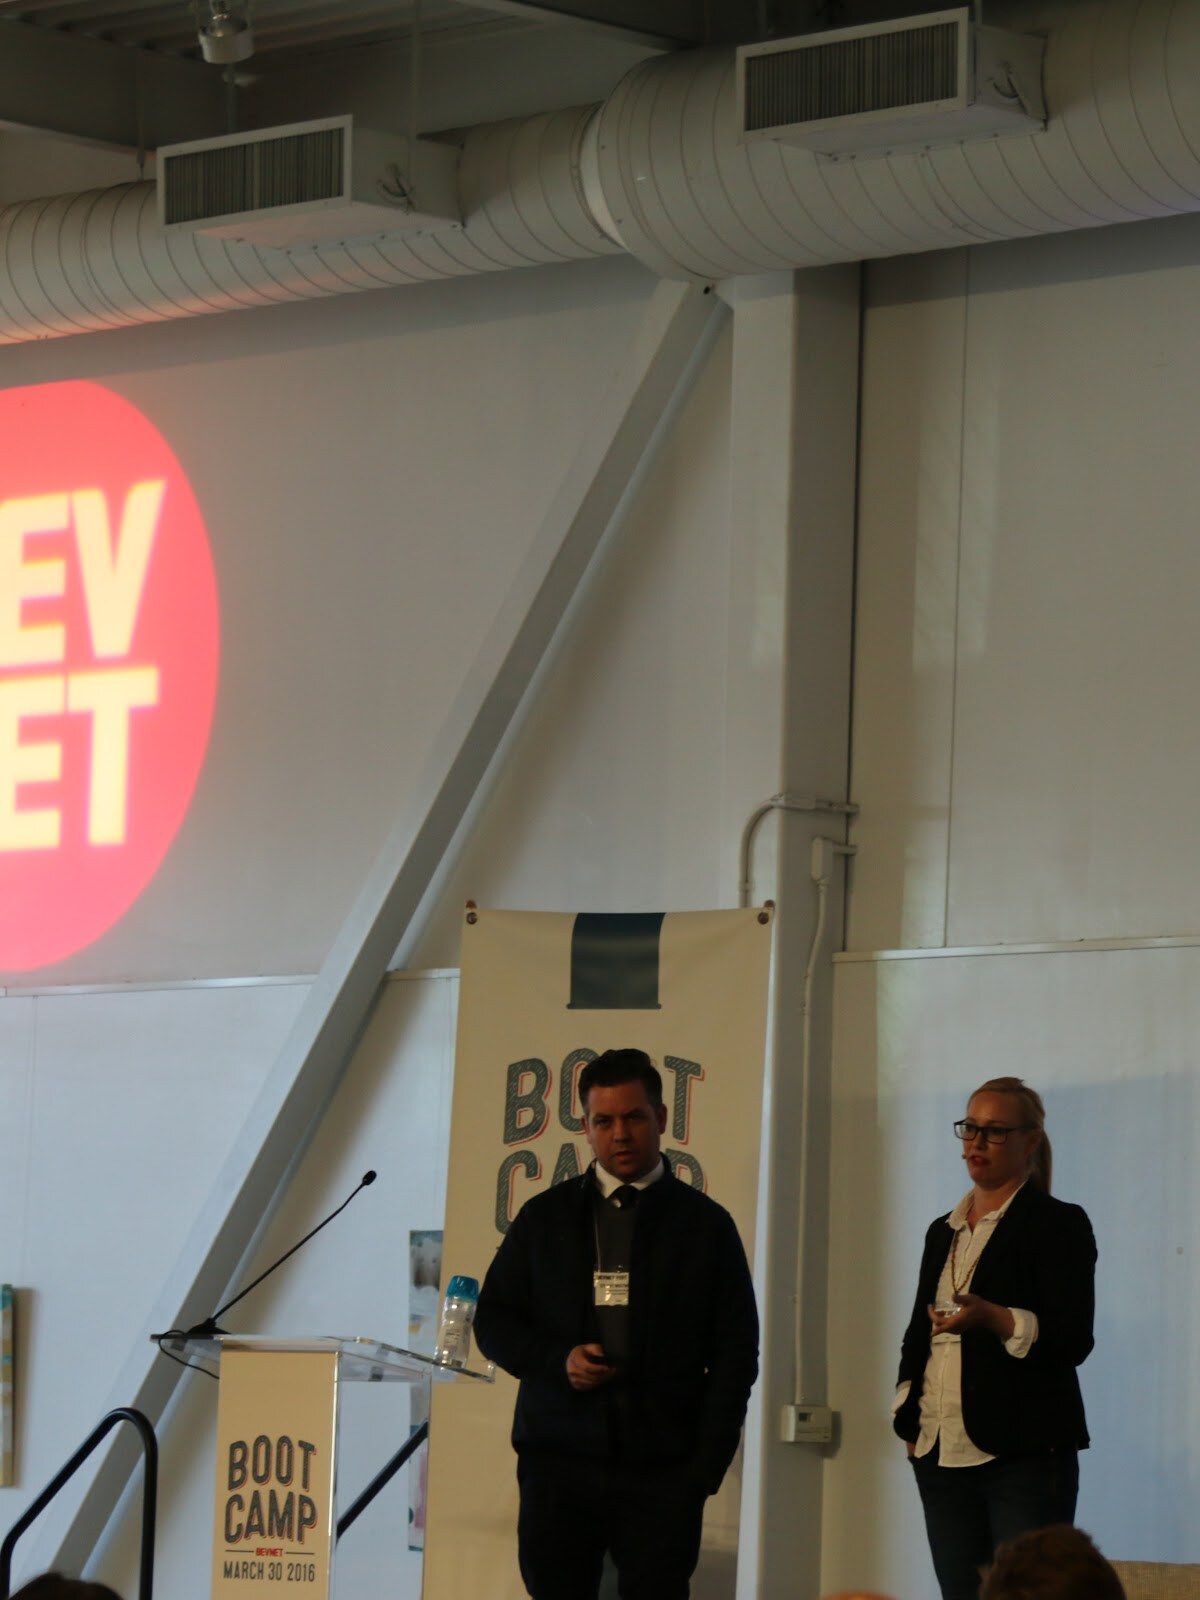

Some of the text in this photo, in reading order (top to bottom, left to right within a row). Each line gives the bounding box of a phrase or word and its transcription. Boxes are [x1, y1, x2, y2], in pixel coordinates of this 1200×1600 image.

[503, 1047, 705, 1147] BOT
[227, 1434, 317, 1493] BOOT
[224, 1488, 319, 1545] CAMP
[223, 1560, 316, 1583] MARCH 30 2016
[255, 1547, 284, 1558] BEVNET
